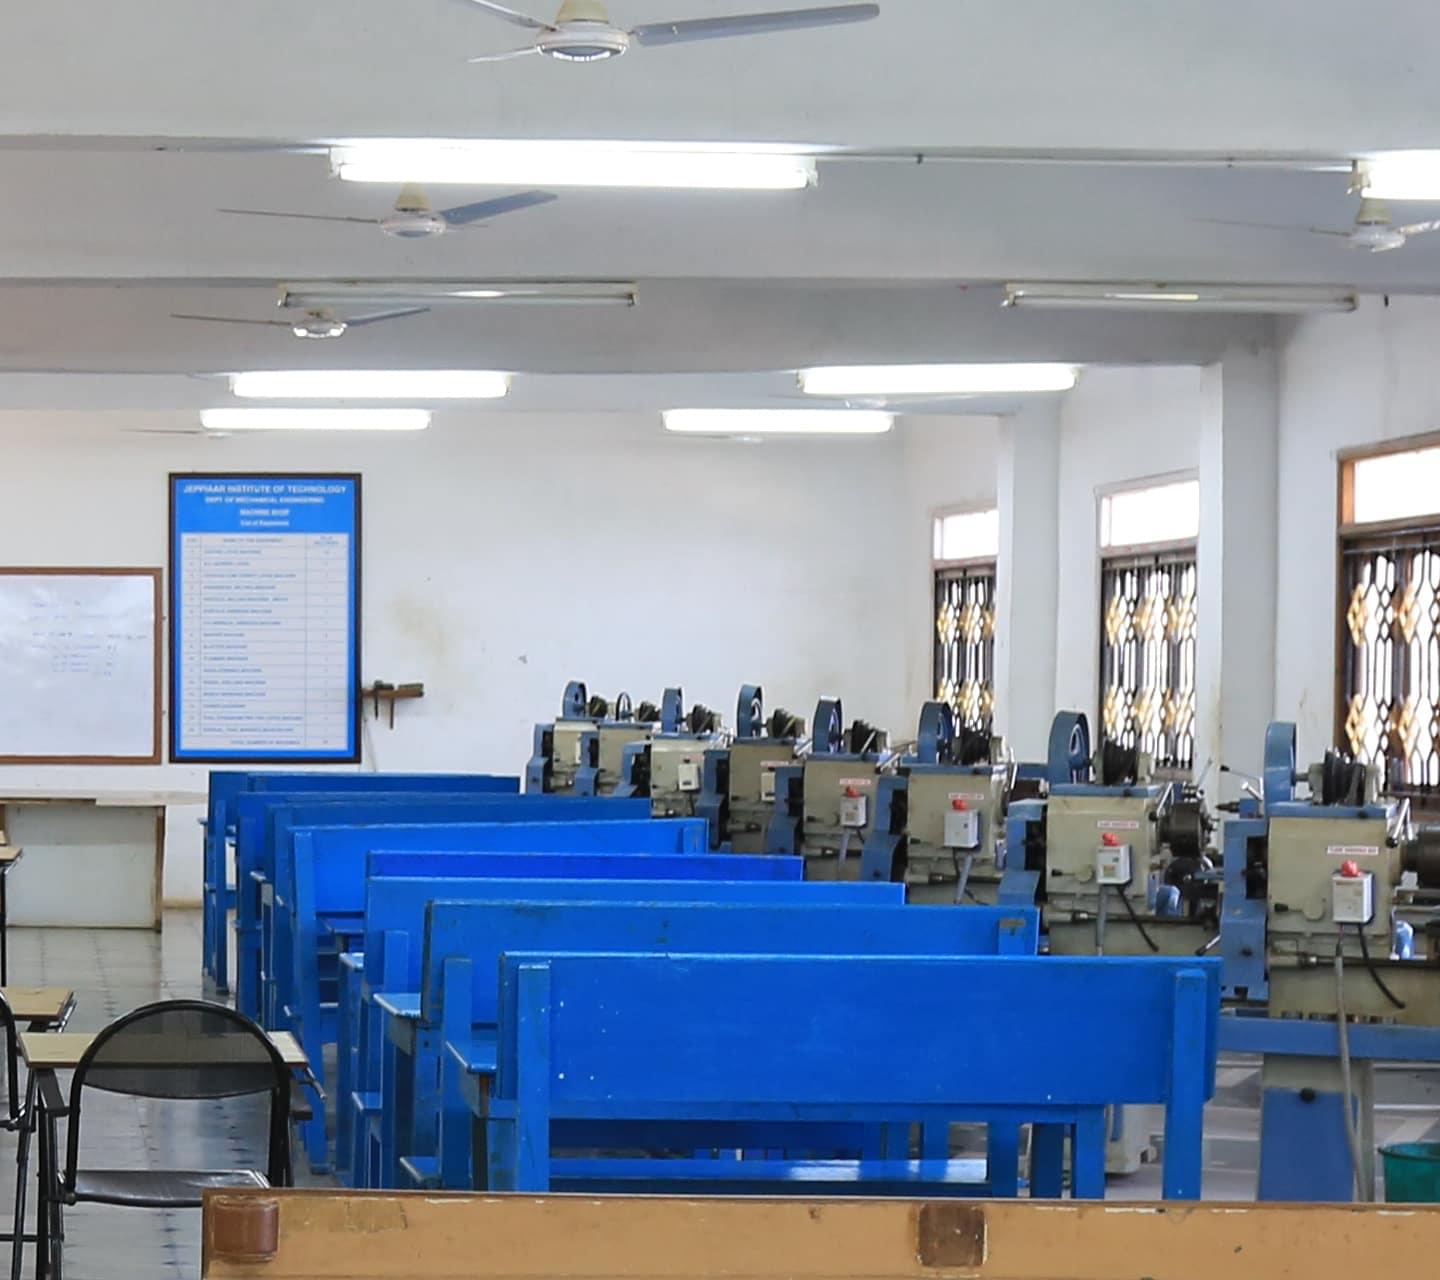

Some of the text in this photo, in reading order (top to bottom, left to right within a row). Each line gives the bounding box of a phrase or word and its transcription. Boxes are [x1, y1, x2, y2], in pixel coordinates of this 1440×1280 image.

[227, 484, 270, 494] INSTITUTE
[272, 484, 285, 494] OF
[287, 484, 346, 494] TECHNOLOGY
[235, 496, 277, 504] MECHANICAL
[279, 496, 324, 504] ENGINEERING
